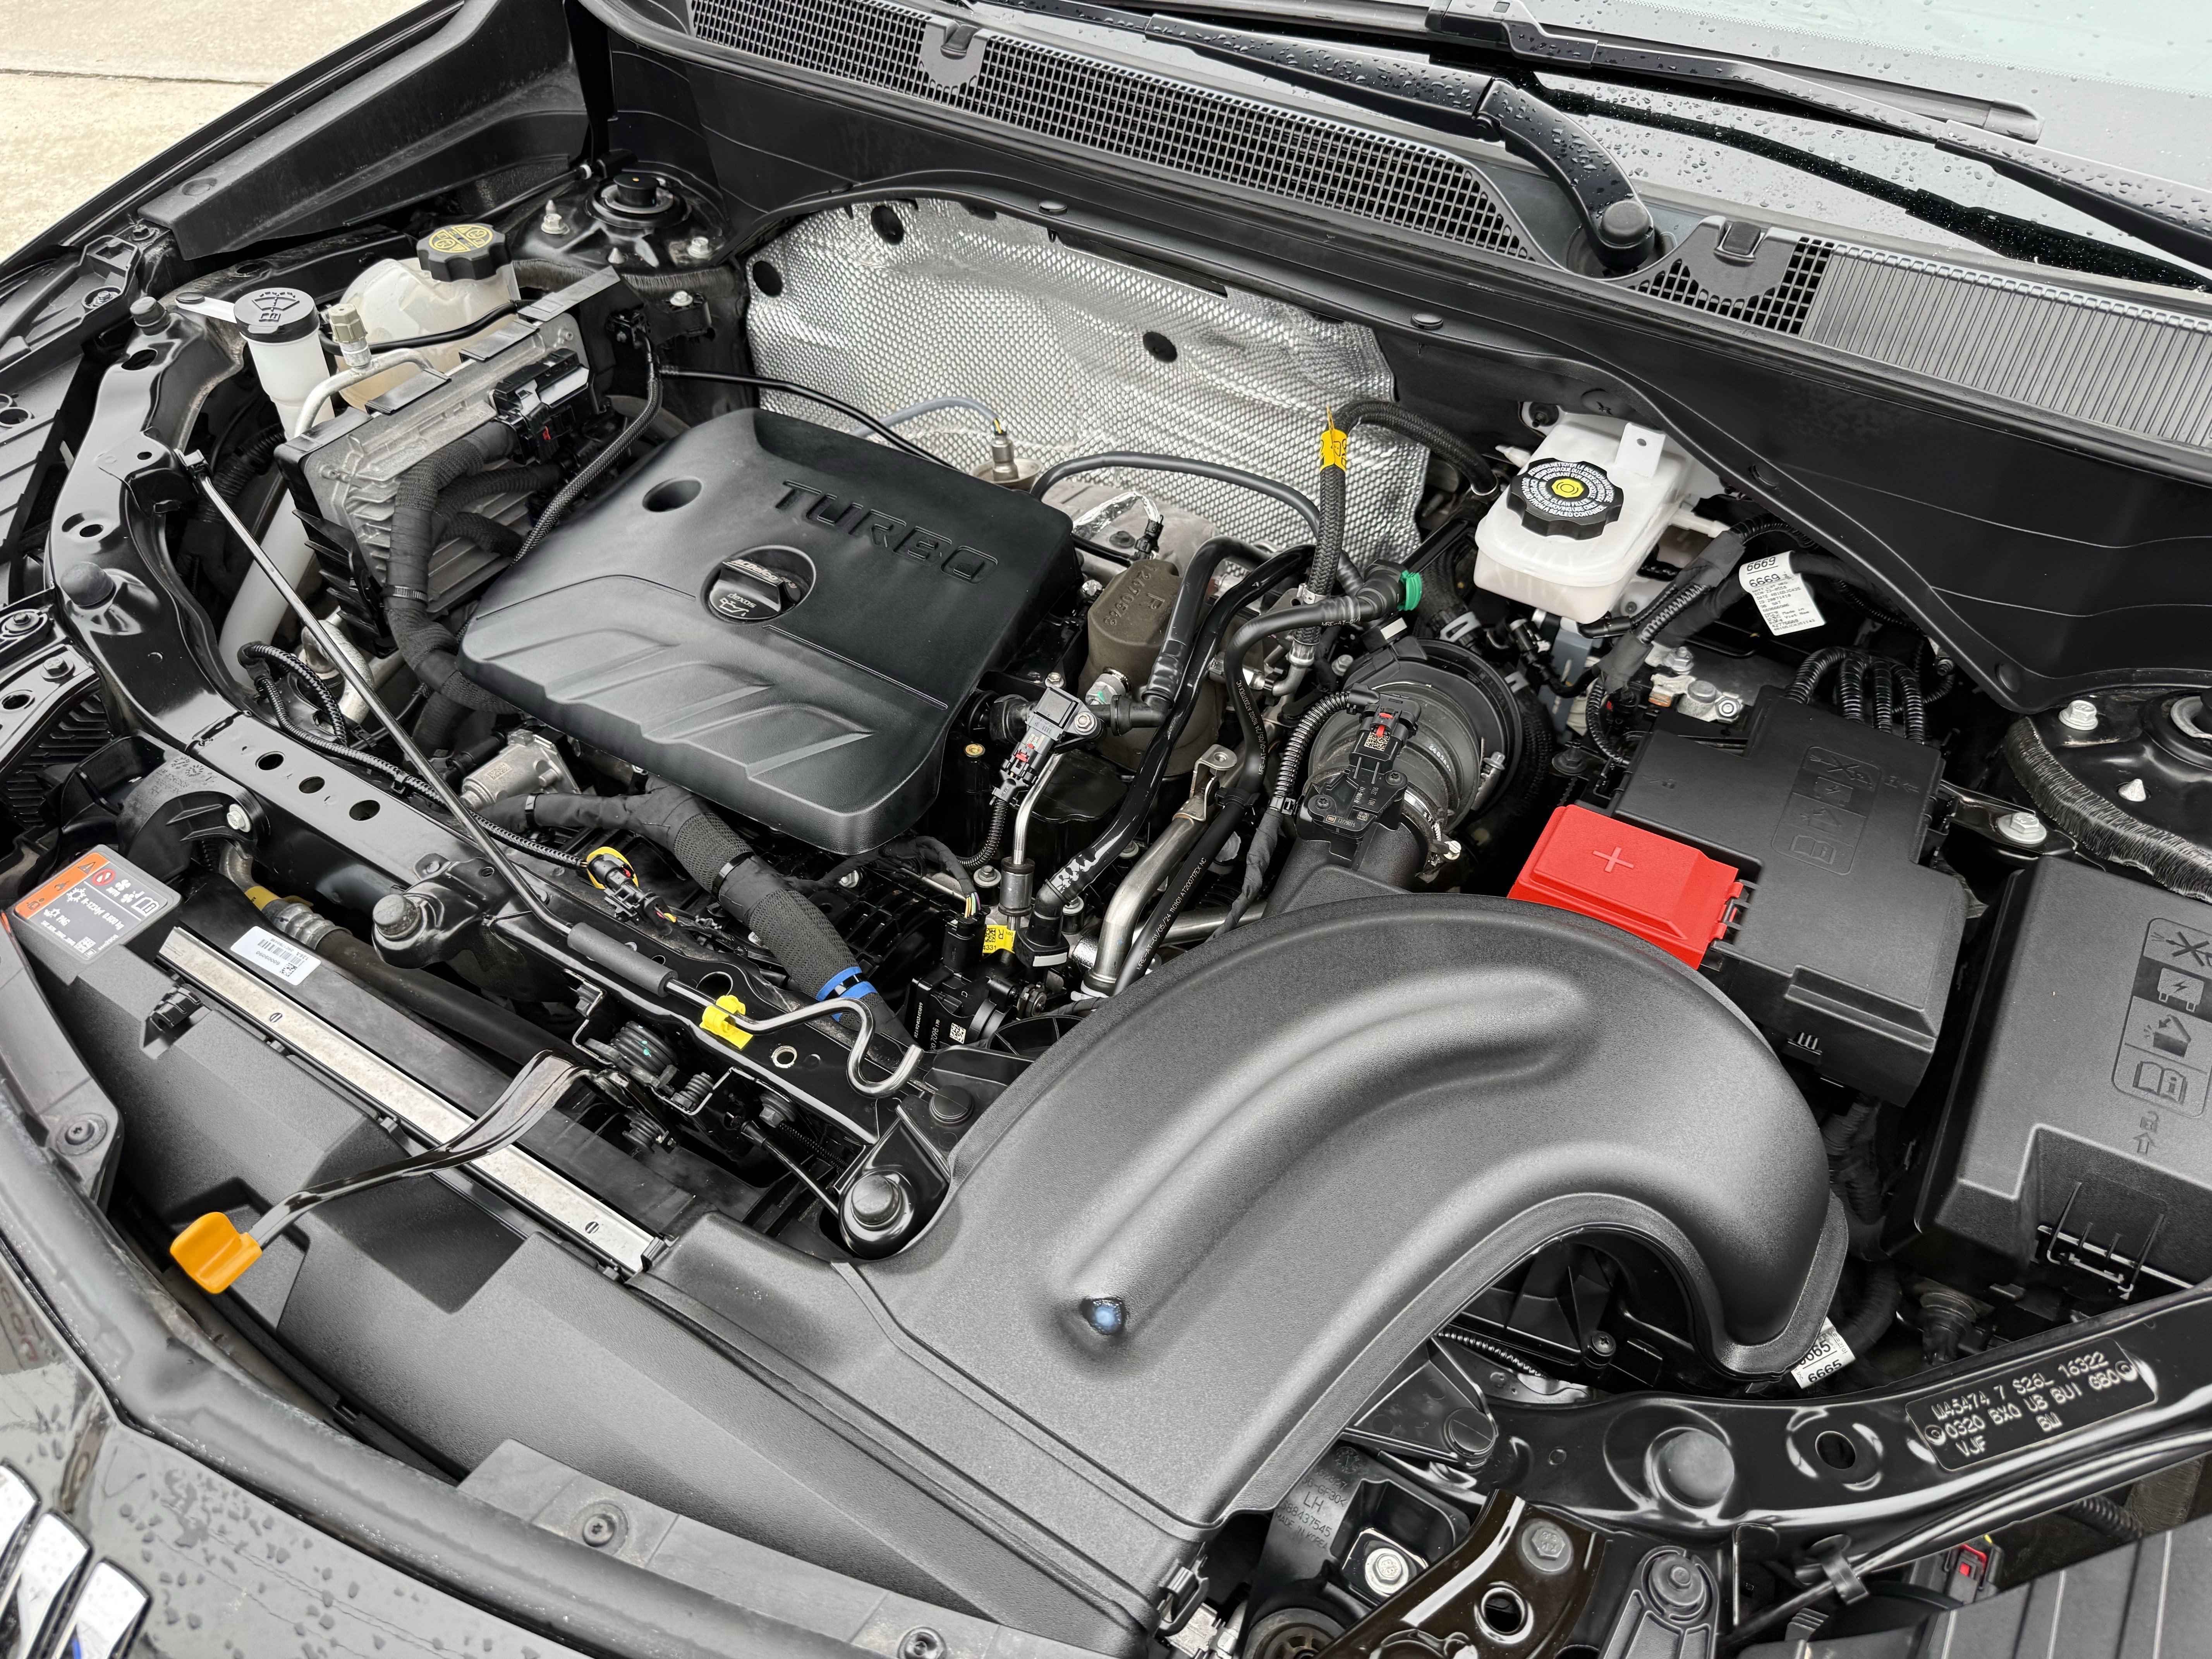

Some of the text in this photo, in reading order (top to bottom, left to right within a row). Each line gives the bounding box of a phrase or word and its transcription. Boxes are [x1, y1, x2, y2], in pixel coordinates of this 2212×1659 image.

[1528, 498, 1546, 510] FROM
[1547, 508, 1573, 517] SEALED
[1530, 487, 1546, 502] BEFORE
[1582, 501, 1599, 510] ONLY
[1549, 497, 1571, 506] CLEAN
[1571, 497, 1592, 506] FILLER
[776, 480, 998, 584] TURBO
[730, 559, 778, 580] ACDelco
[1747, 556, 1776, 571] 6669
[1749, 574, 1781, 587] 6669
[727, 593, 757, 608] dexos
[56, 914, 71, 926] PAG
[296, 952, 309, 961] 136A
[1808, 1359, 1842, 1382] 6665
[1993, 1385, 2006, 1401] 7
[2013, 1372, 2055, 1395] S26L
[2058, 1351, 2109, 1379] 16322
[1944, 1414, 1986, 1439] 0320
[1955, 1434, 1987, 1458] VJF
[1304, 1492, 1324, 1512] LH
[1274, 1511, 1328, 1549] MADE IN KOREA
